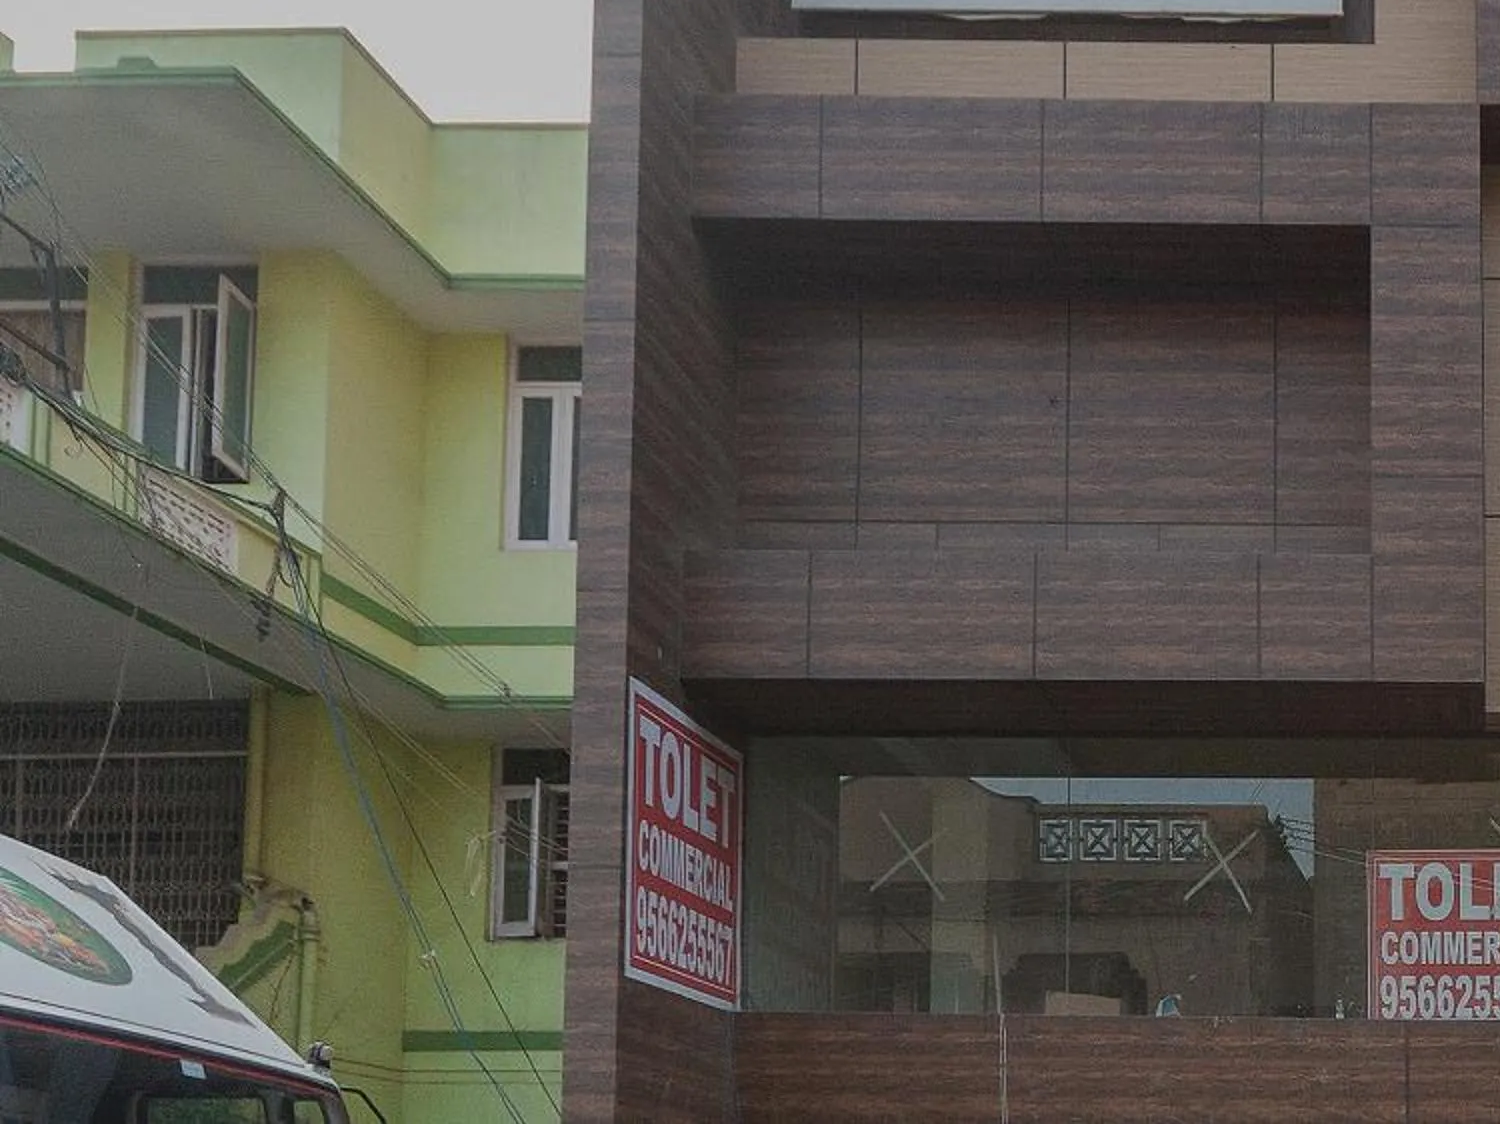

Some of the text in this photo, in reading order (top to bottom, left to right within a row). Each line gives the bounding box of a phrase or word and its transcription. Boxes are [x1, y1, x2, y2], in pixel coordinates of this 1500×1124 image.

[639, 715, 735, 848] TOLET
[638, 820, 733, 913] COMMERCIAL
[637, 885, 734, 986] 9566255567
